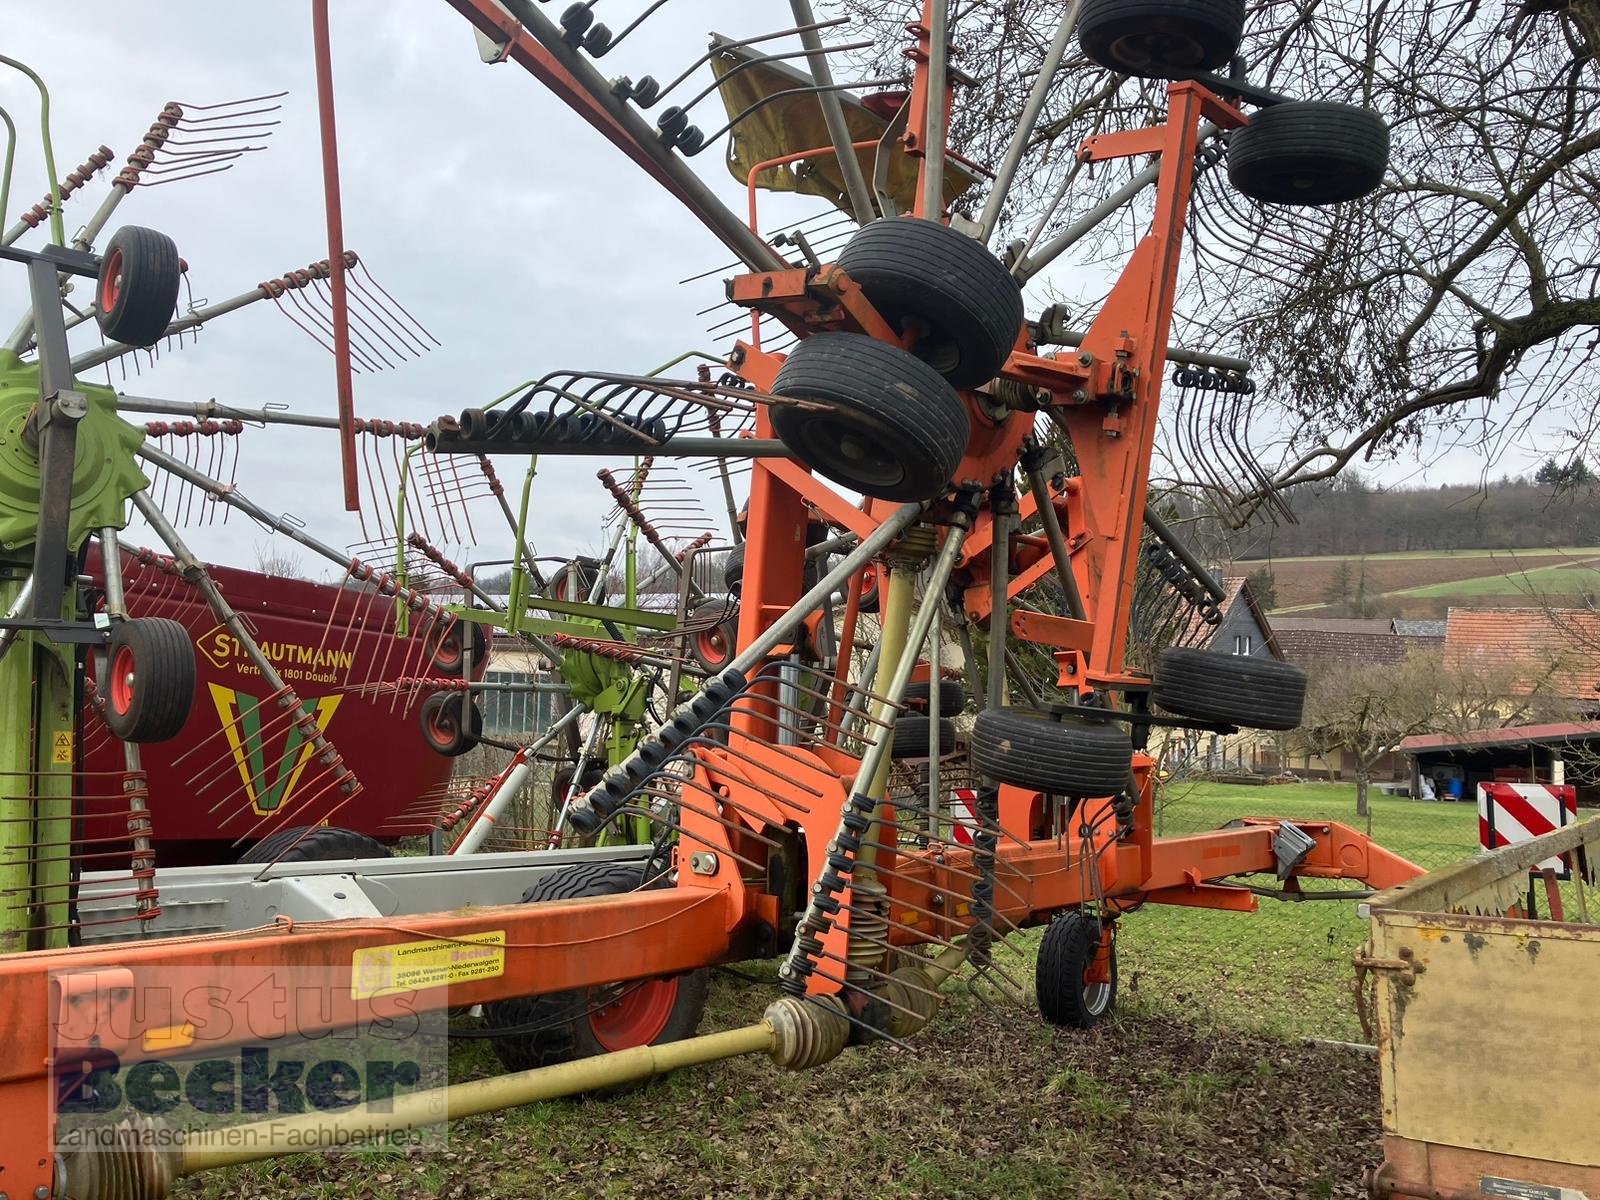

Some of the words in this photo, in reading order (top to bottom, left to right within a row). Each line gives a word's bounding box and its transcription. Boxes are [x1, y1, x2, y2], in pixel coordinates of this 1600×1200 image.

[212, 633, 353, 670] STAUTMANN
[284, 668, 303, 680] 1801
[305, 671, 338, 684] Double
[396, 970, 421, 980] 35096
[423, 958, 500, 975] Weimar-Niederwalgern
[408, 977, 430, 986] 06426
[457, 970, 470, 978] Fax
